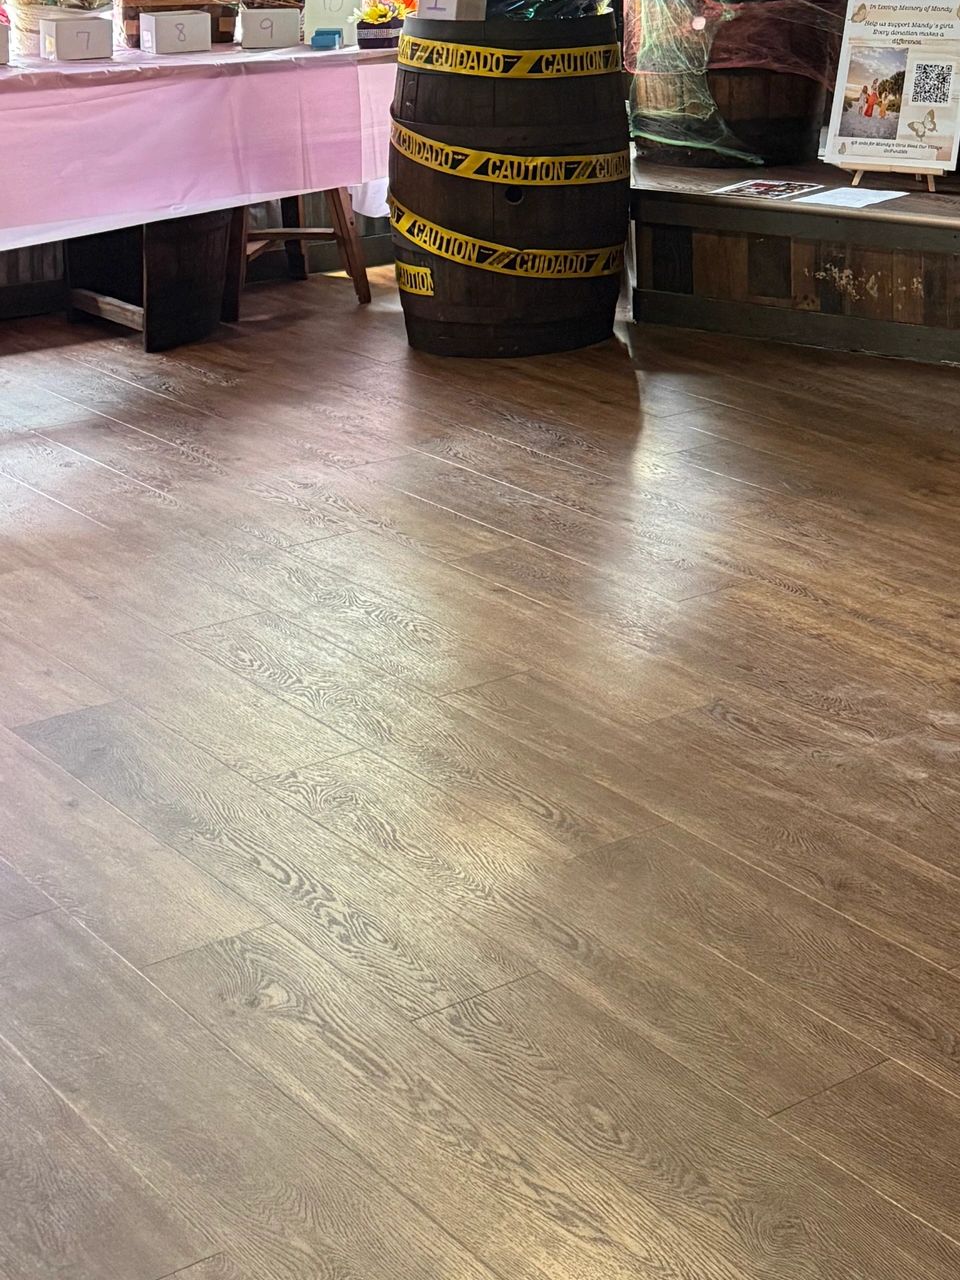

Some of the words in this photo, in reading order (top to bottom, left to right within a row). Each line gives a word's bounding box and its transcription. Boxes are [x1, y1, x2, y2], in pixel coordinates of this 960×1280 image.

[898, 5, 923, 13] Memory
[930, 6, 953, 14] Mandy
[175, 22, 186, 42] 8
[259, 17, 275, 40] 9
[872, 29, 889, 37] Every
[75, 31, 91, 51] 7
[432, 46, 505, 73] CUIDADO
[541, 51, 604, 72] CAUTION
[400, 131, 453, 169] CUIDADO
[487, 158, 566, 181] CAUTION
[414, 222, 480, 263] CAUTION
[515, 252, 588, 275] CUIDADO
